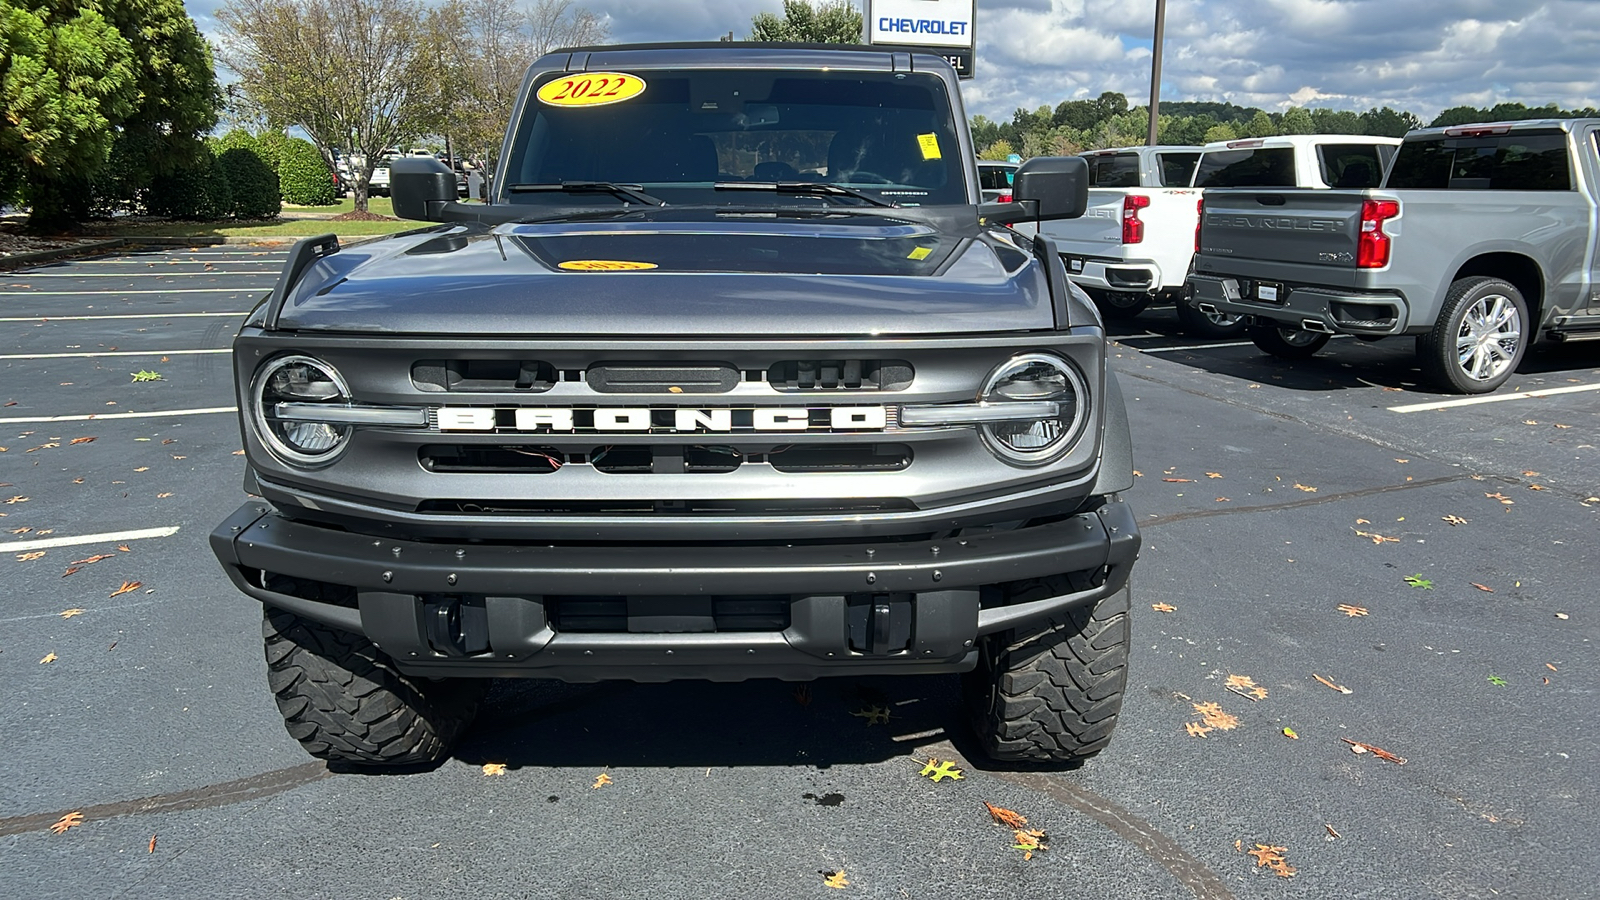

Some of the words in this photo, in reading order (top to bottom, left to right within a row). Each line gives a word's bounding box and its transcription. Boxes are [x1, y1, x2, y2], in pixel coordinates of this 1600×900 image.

[879, 17, 967, 35] CHEVROLET
[942, 56, 964, 69] EL
[552, 77, 626, 100] 2022
[1207, 216, 1345, 231] CHEVROLET
[437, 406, 886, 431] BRONCO
